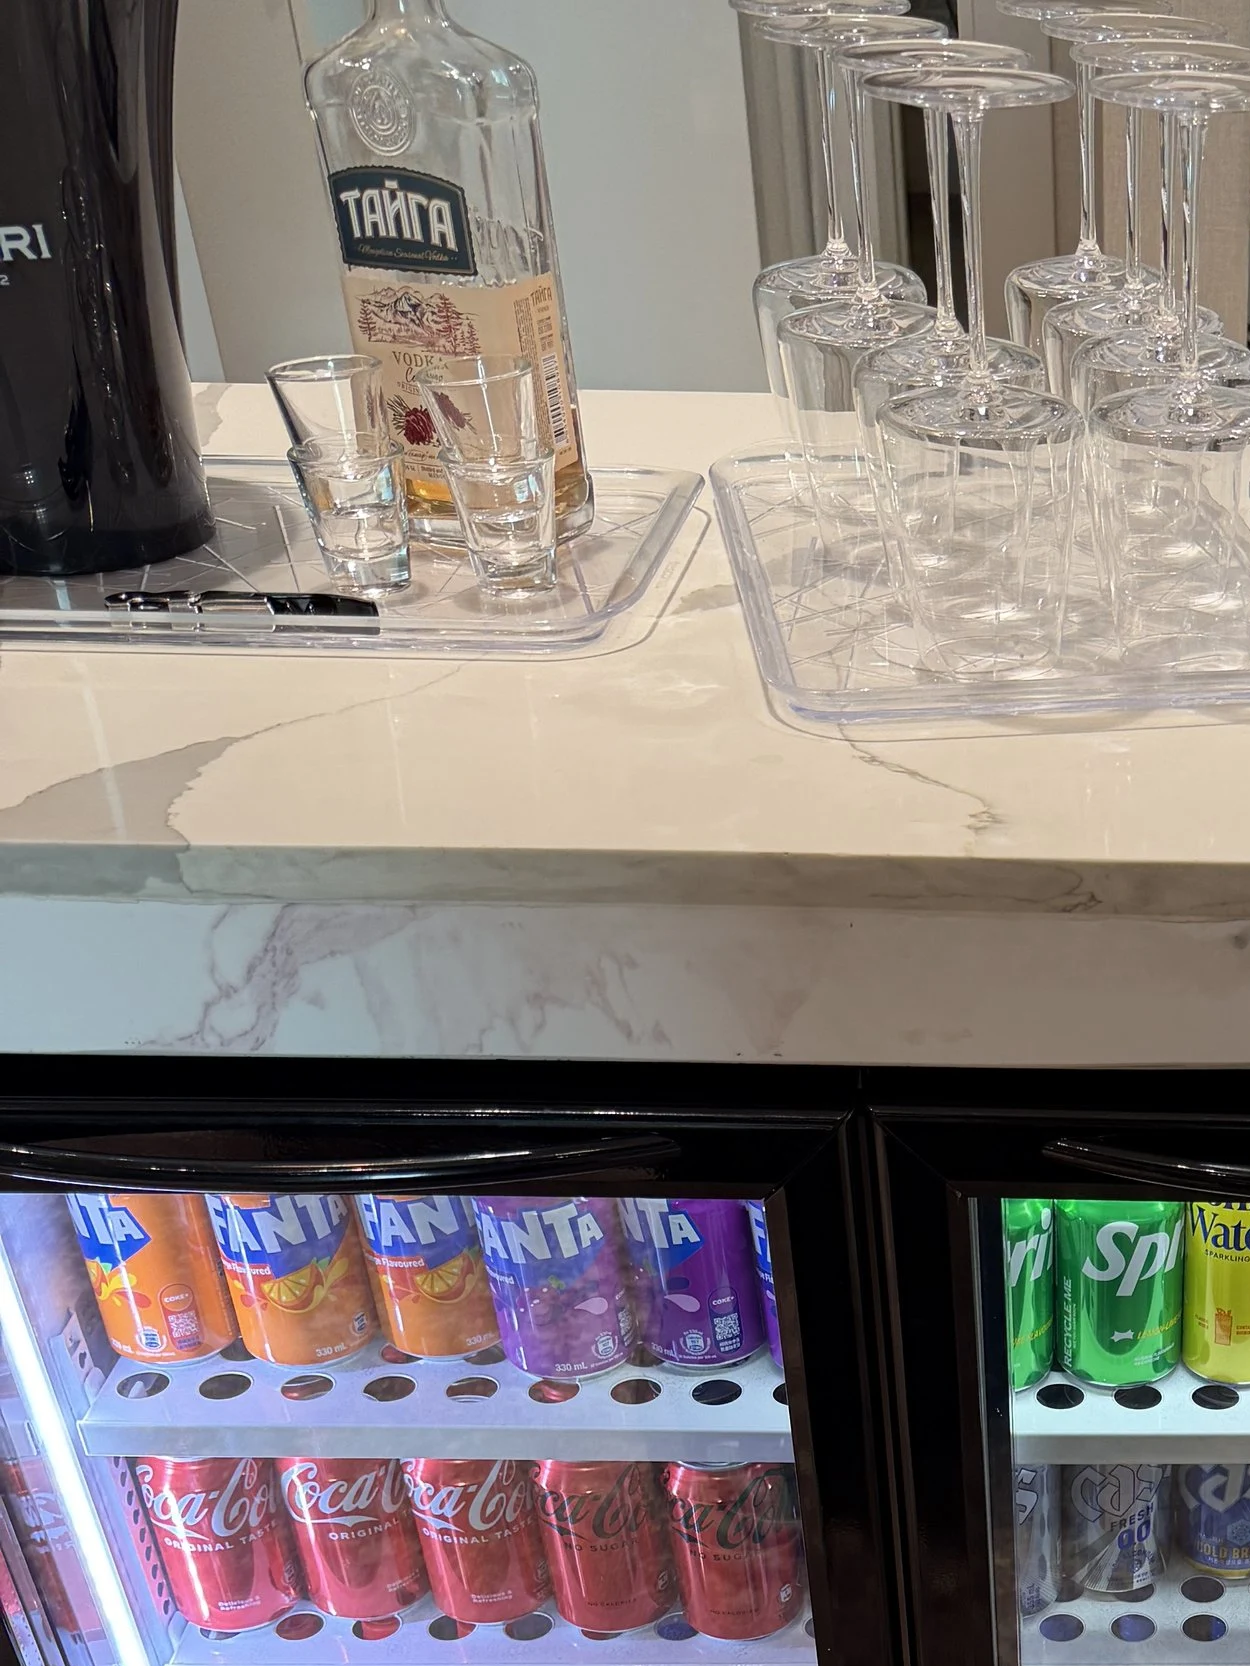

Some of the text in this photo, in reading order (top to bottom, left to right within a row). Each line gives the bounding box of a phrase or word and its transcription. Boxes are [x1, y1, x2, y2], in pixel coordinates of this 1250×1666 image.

[340, 180, 459, 252] ТАЙГА
[0, 224, 52, 261] RI
[1205, 1250, 1250, 1263] SPARKLING
[1063, 1278, 1073, 1297] ME
[1063, 1300, 1073, 1368] RECYCLE
[555, 1363, 573, 1373] 330
[1110, 1502, 1154, 1532] FRESH
[328, 1518, 399, 1541] ORIGINAL
[422, 1527, 488, 1545] ORIGINAL
